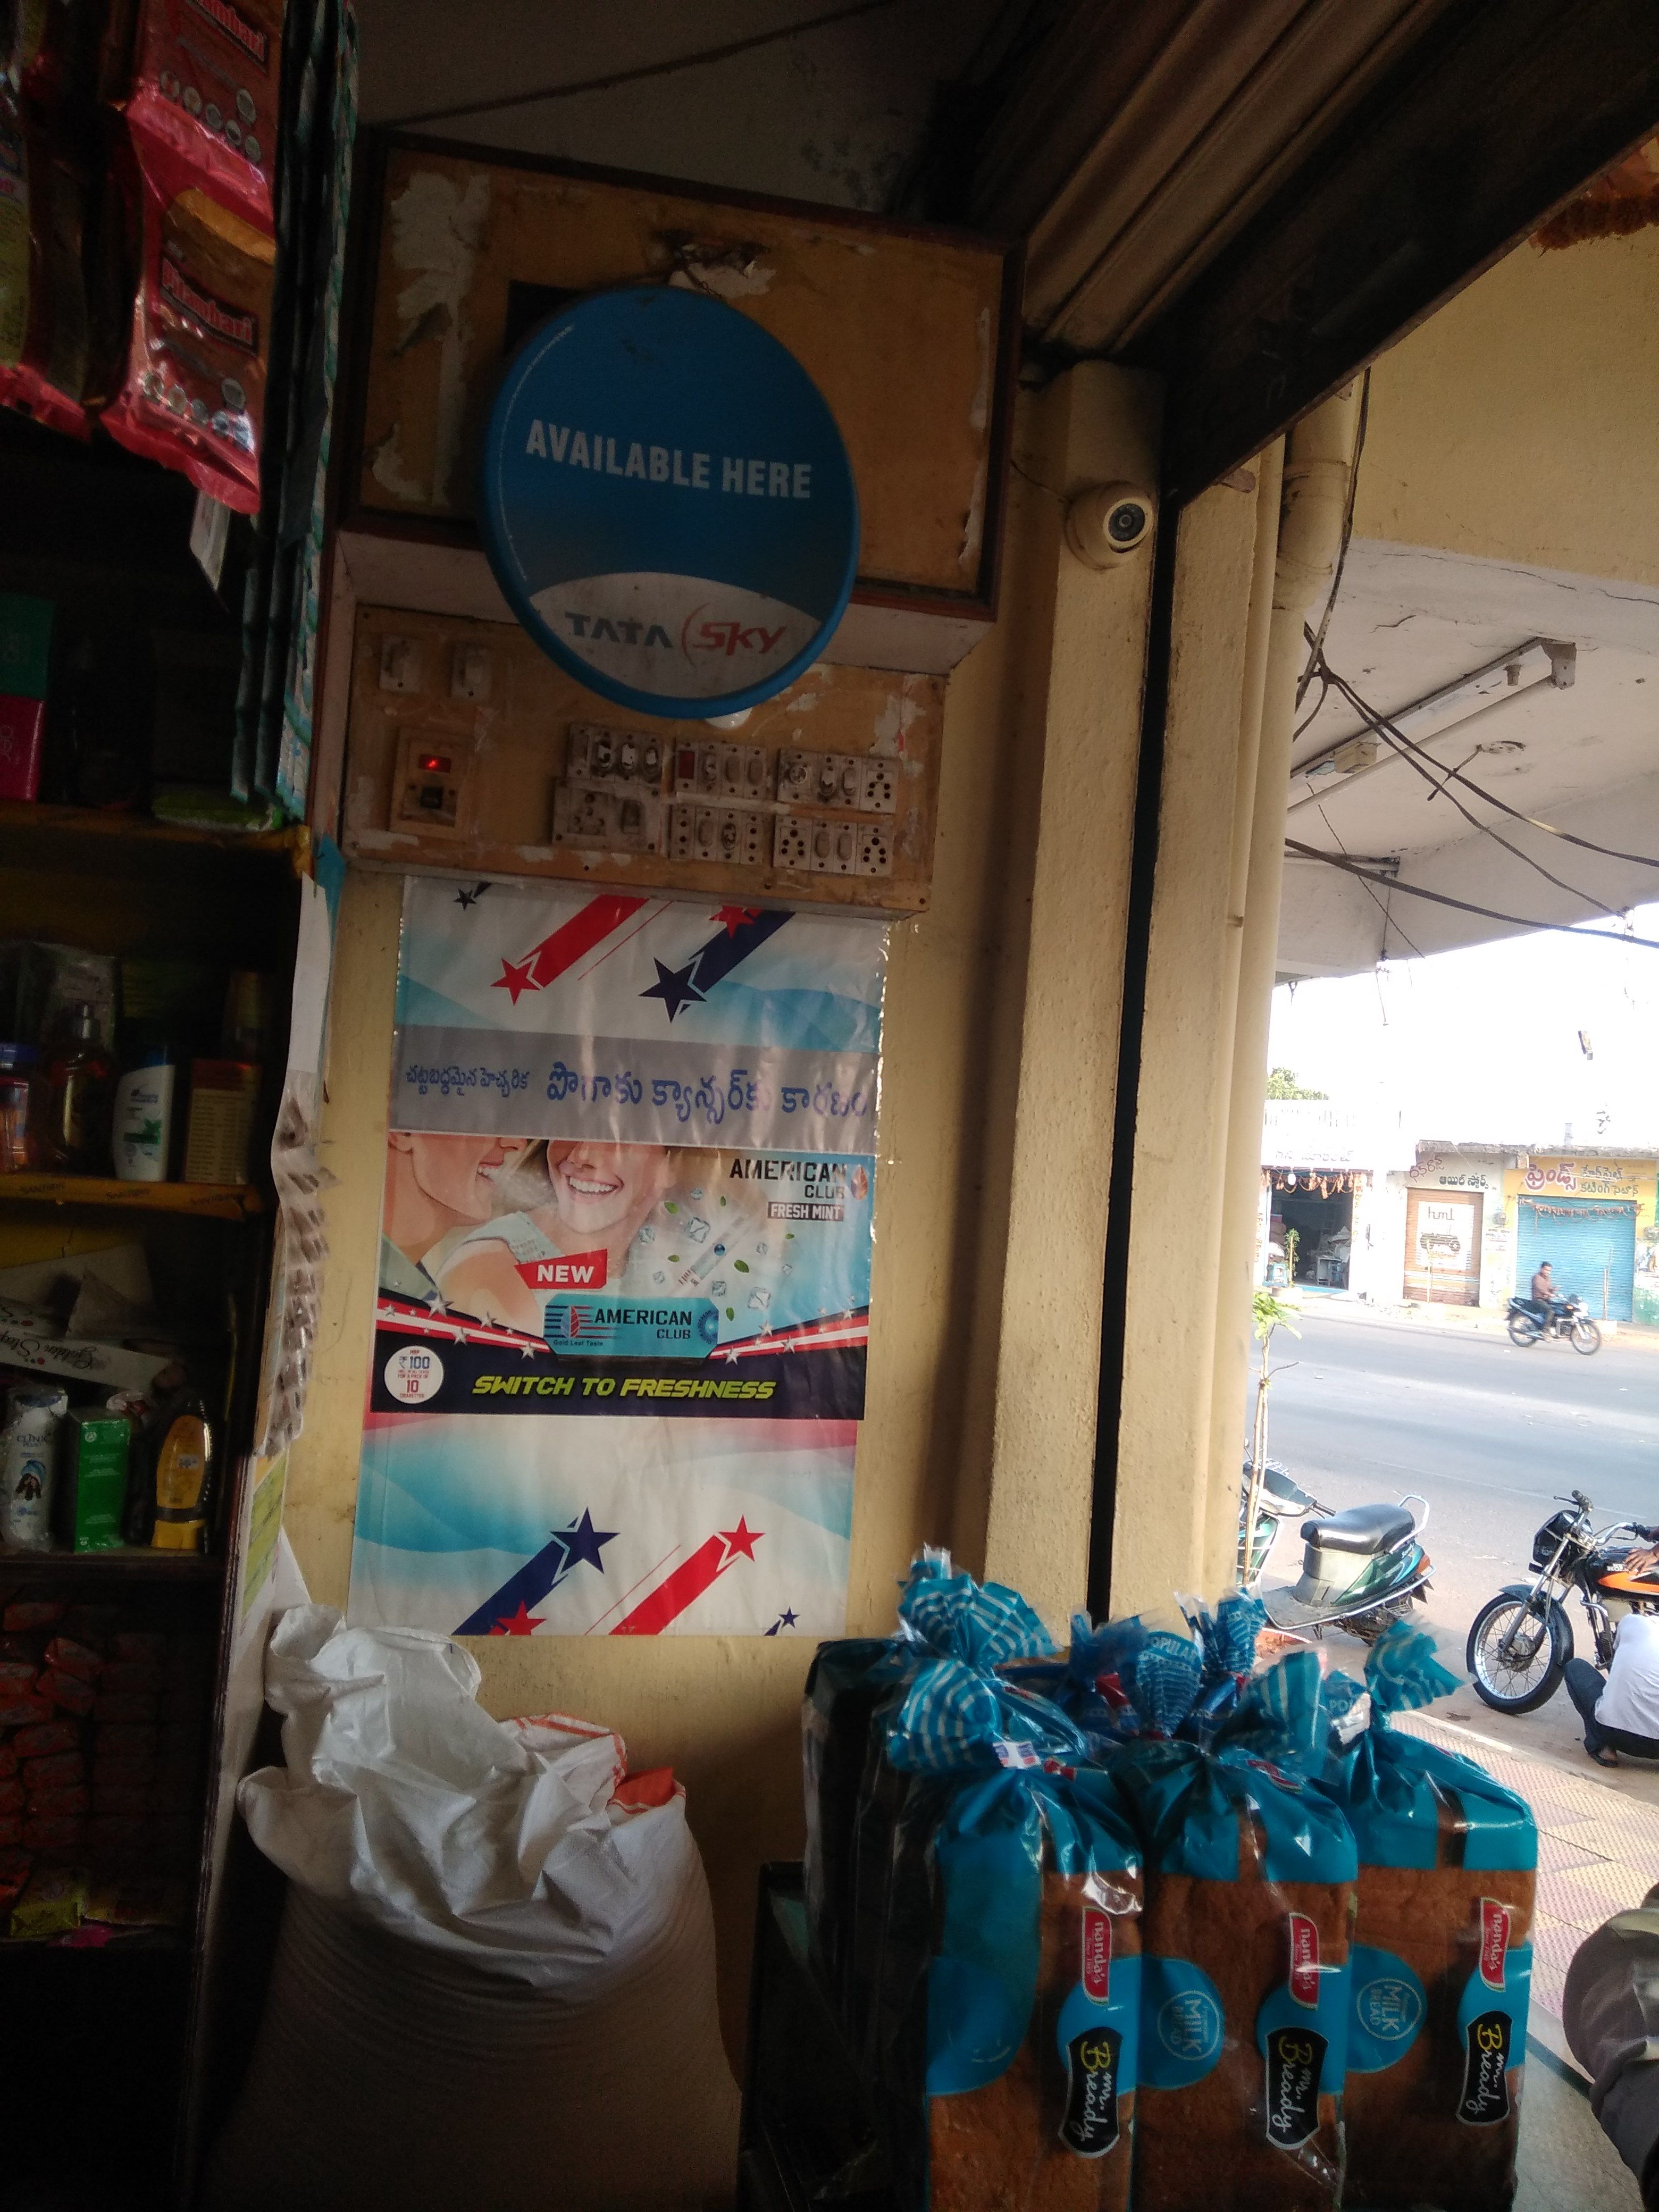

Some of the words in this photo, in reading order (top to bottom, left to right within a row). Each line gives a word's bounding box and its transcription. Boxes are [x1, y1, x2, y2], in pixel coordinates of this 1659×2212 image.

[526, 419, 710, 488] AVAILABLE
[722, 457, 811, 499] HERE
[565, 611, 673, 649] TATA
[730, 1159, 846, 1183] AMERICAN
[770, 1203, 809, 1219] FRESH
[812, 1204, 841, 1220] MINT
[805, 1185, 844, 1200] CLUB
[537, 1264, 594, 1284] NEW
[594, 1309, 692, 1326] AMERICAN
[657, 1329, 690, 1339] CLUB
[406, 1379, 419, 1393] 10
[472, 1376, 575, 1396] SWITCH
[582, 1378, 616, 1396] TO
[619, 1379, 776, 1400] FRESHNESS
[1093, 1921, 1107, 1984] nanda's
[1489, 1913, 1505, 1971] nanda's
[1182, 1998, 1202, 2052] MILK
[1382, 1984, 1403, 2032] MILK
[1271, 2035, 1313, 2133] Bready
[1465, 2023, 1503, 2115] Bready
[1069, 2040, 1112, 2142] Bready
